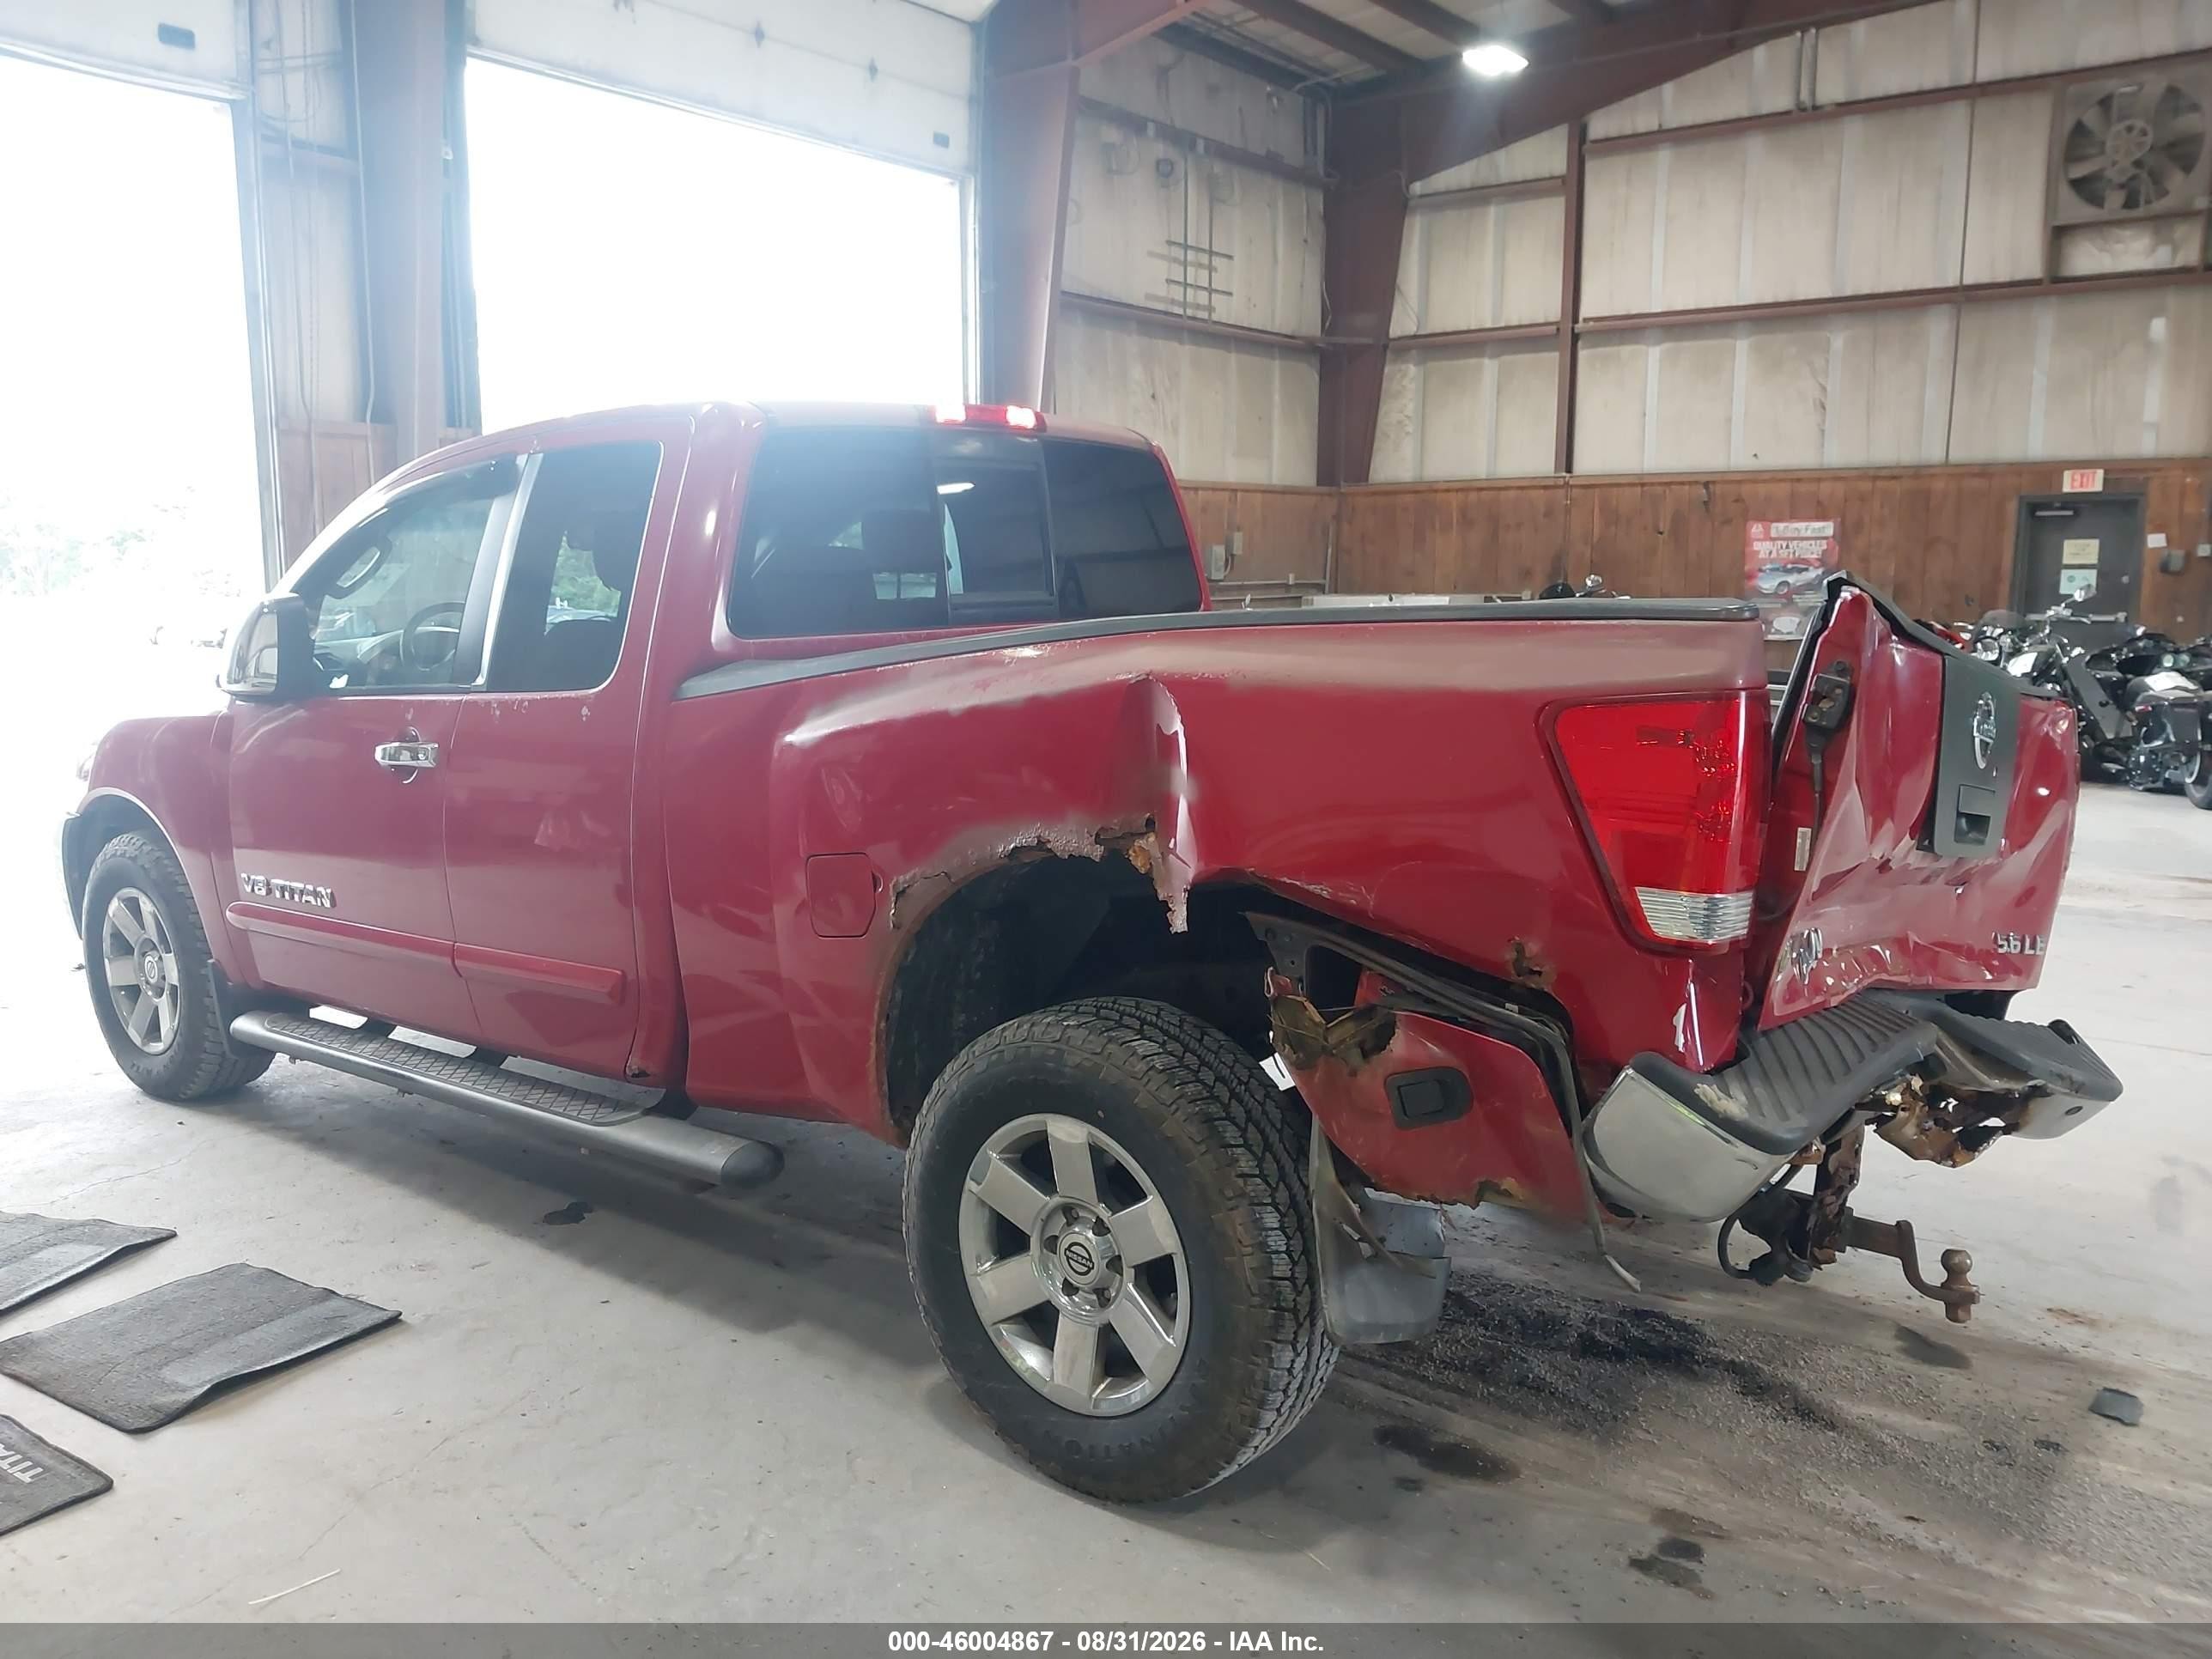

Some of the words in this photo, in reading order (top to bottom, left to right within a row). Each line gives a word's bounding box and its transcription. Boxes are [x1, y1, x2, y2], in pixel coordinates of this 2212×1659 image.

[2070, 470, 2096, 490] EXIT
[240, 872, 270, 896] V8
[270, 878, 334, 908] TITAN
